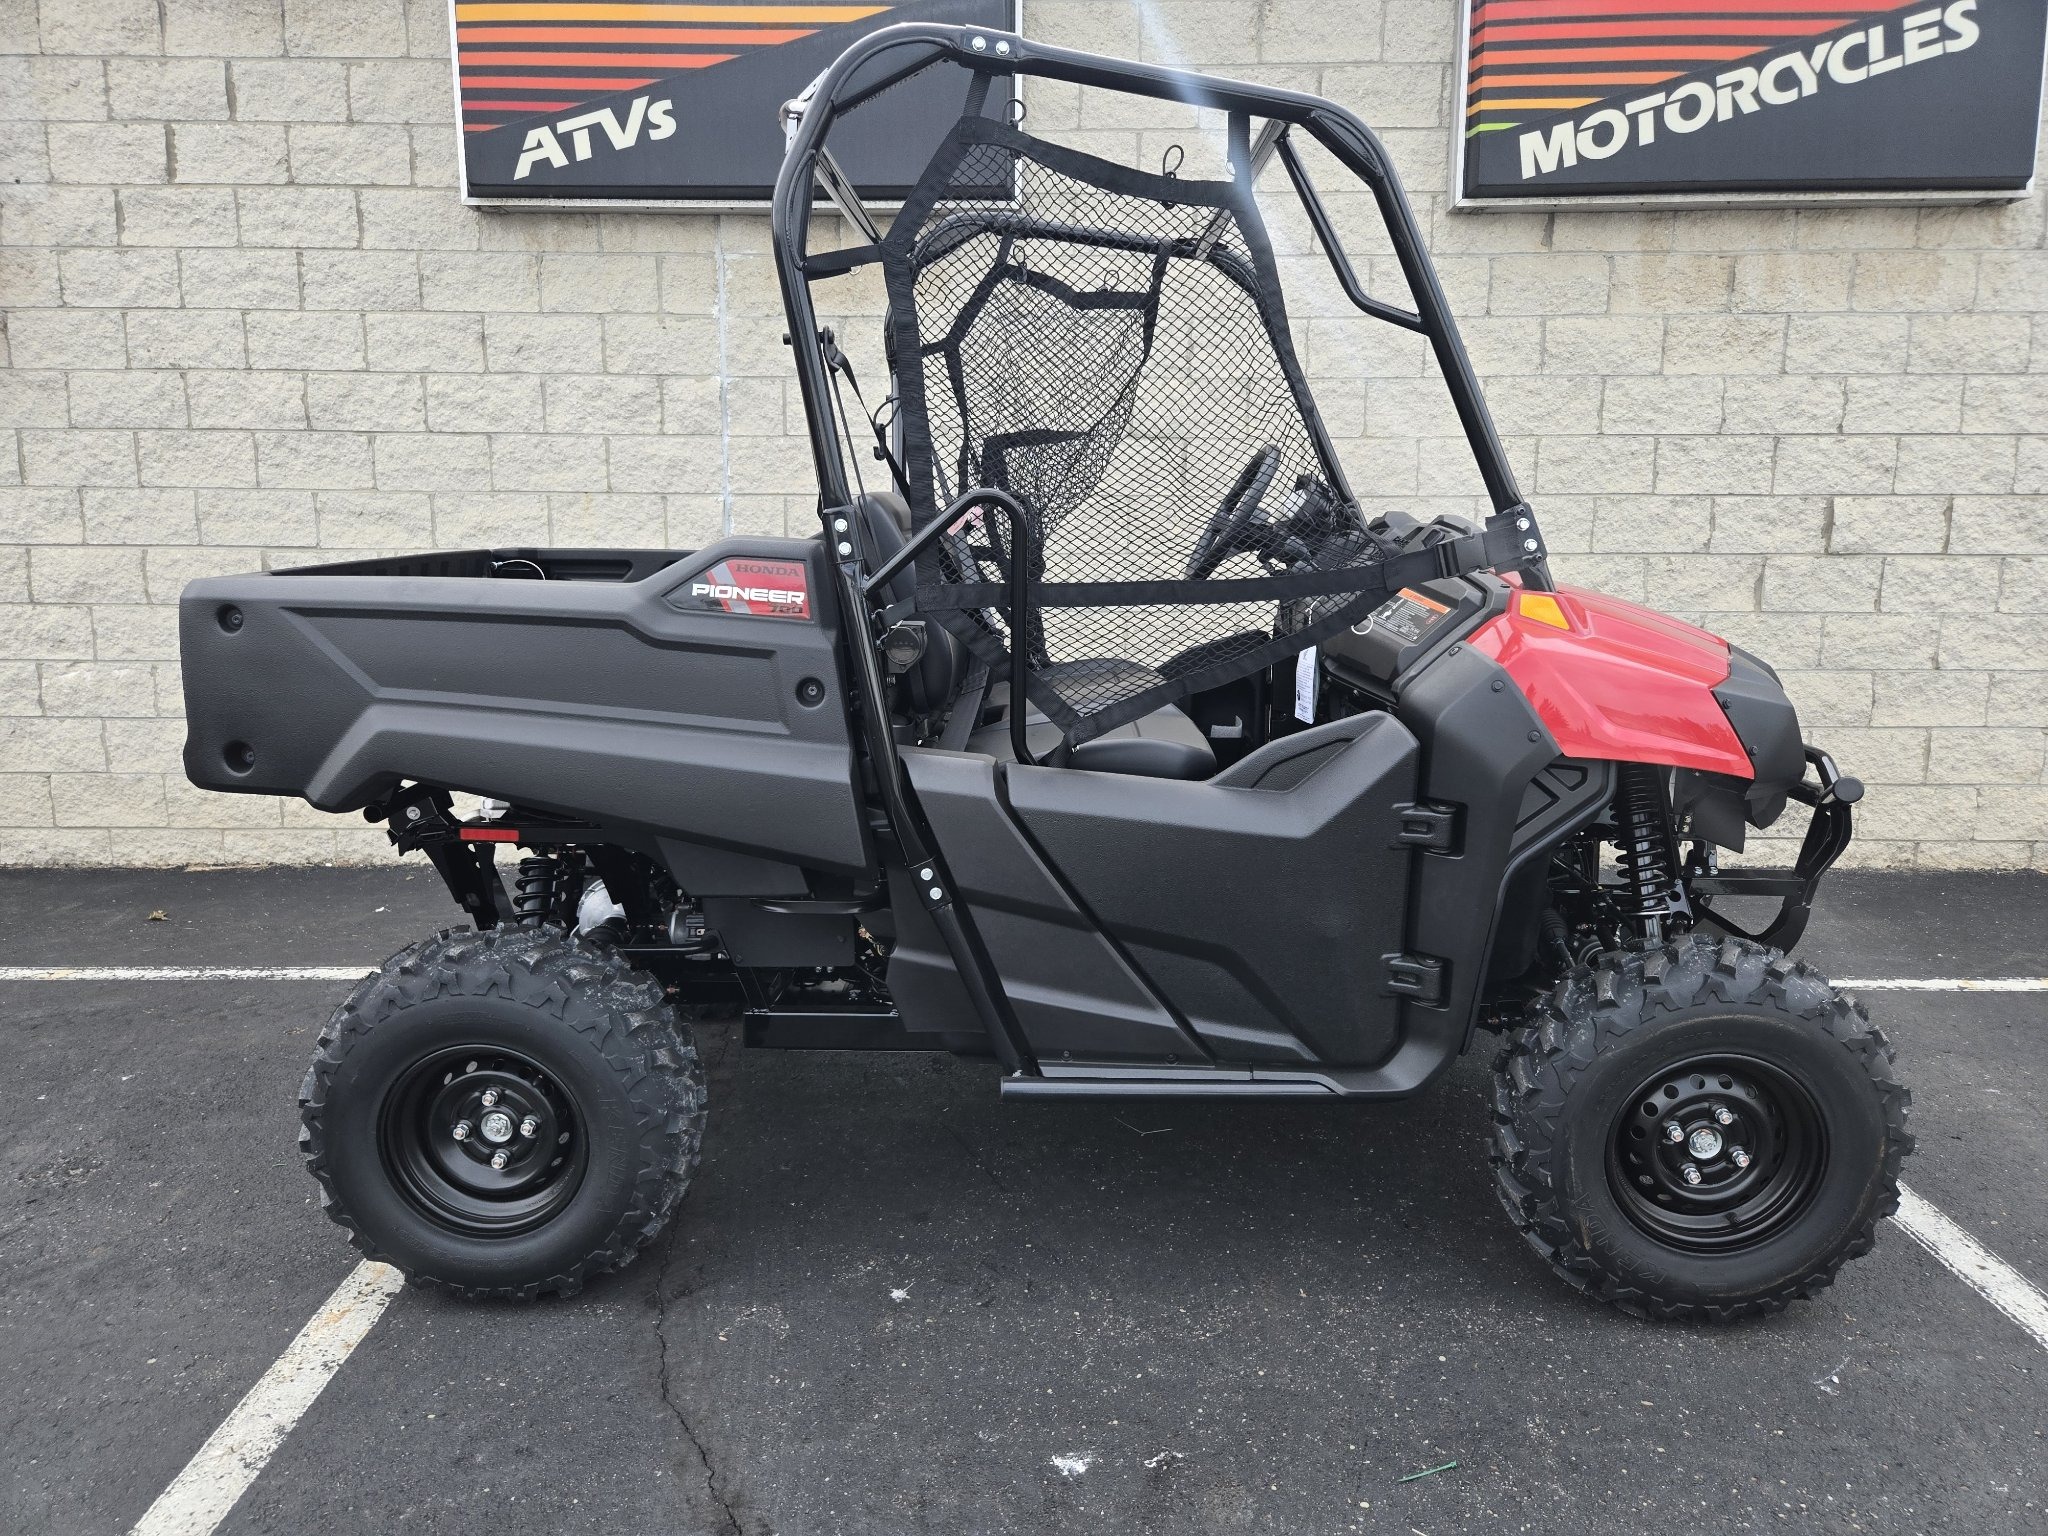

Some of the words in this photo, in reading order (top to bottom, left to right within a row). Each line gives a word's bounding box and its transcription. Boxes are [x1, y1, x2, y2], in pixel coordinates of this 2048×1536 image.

[1519, 0, 1980, 180] MOTORCYCLES
[735, 563, 800, 577] HONDA
[691, 583, 806, 605] PIONEER
